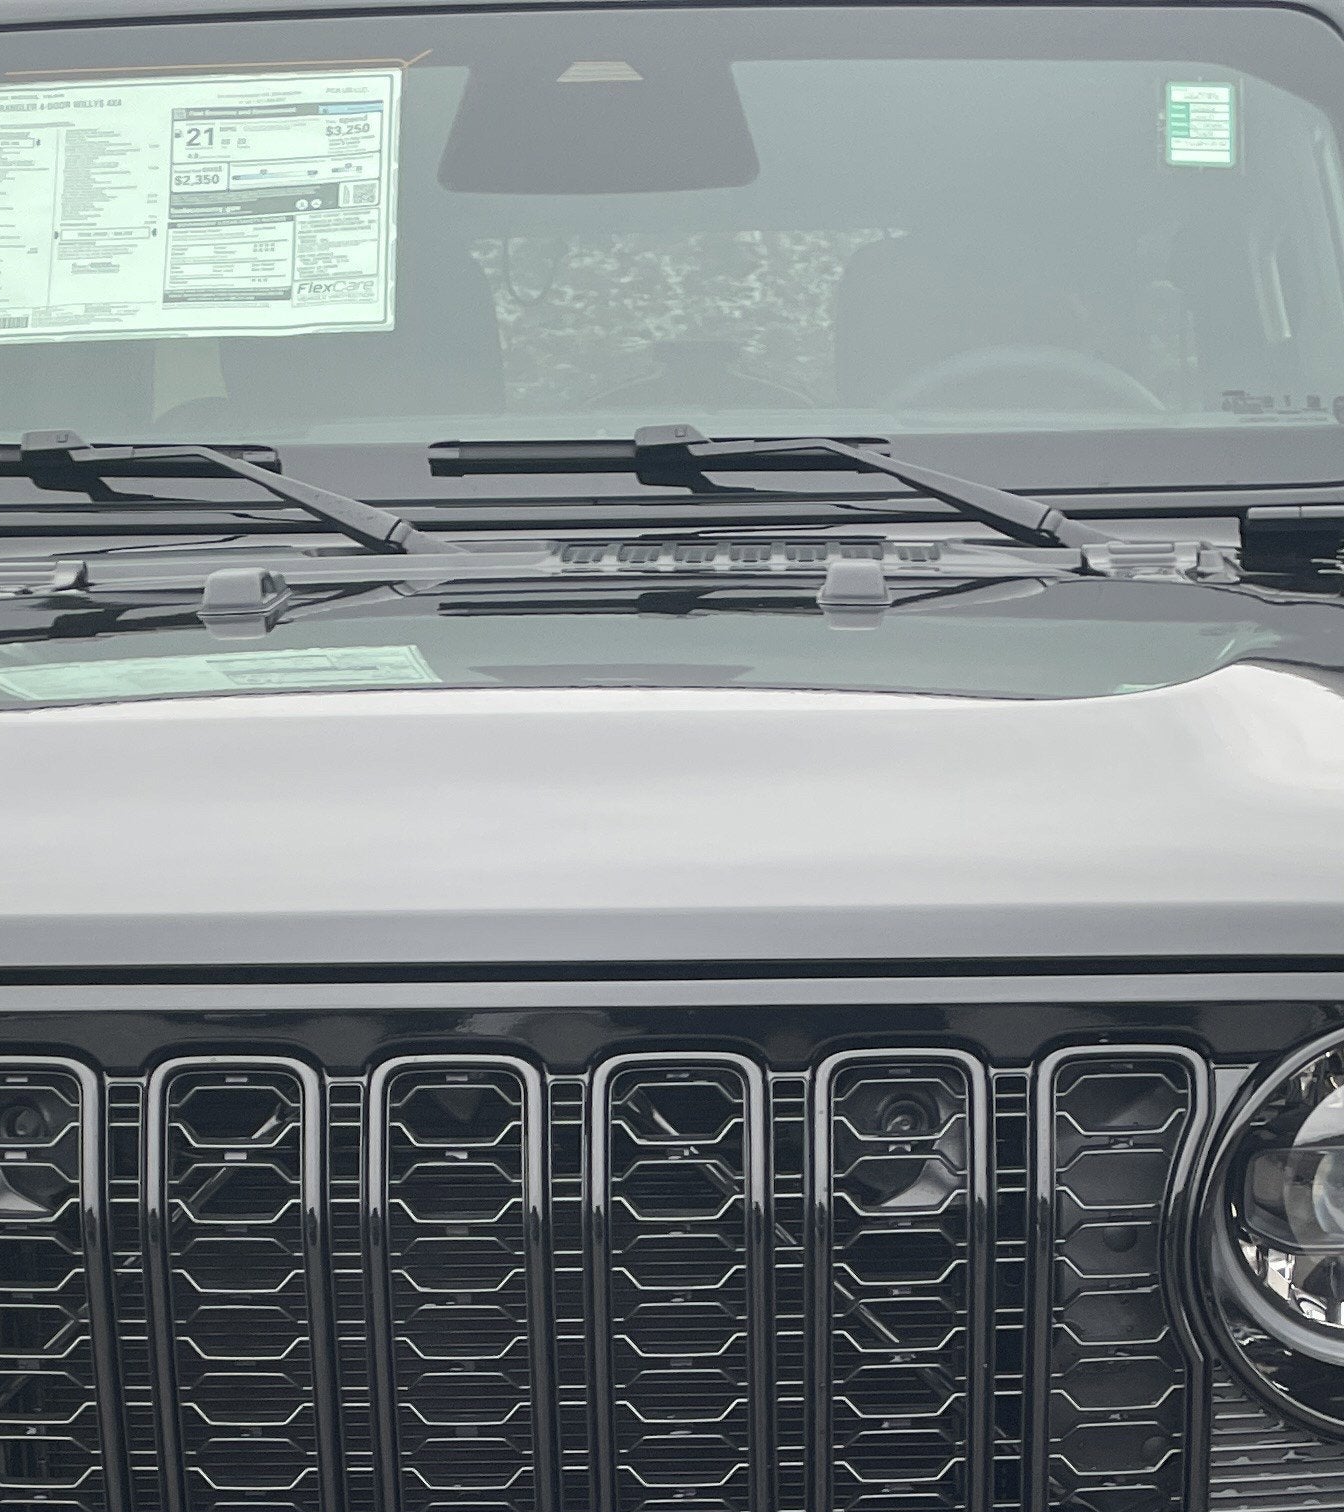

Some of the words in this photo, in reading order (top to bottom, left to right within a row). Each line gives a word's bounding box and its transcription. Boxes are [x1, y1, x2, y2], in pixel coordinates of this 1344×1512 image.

[186, 127, 214, 147] 21
[325, 123, 370, 137] $3,250
[174, 174, 220, 187] $2,350
[297, 280, 375, 295] FlexCare
